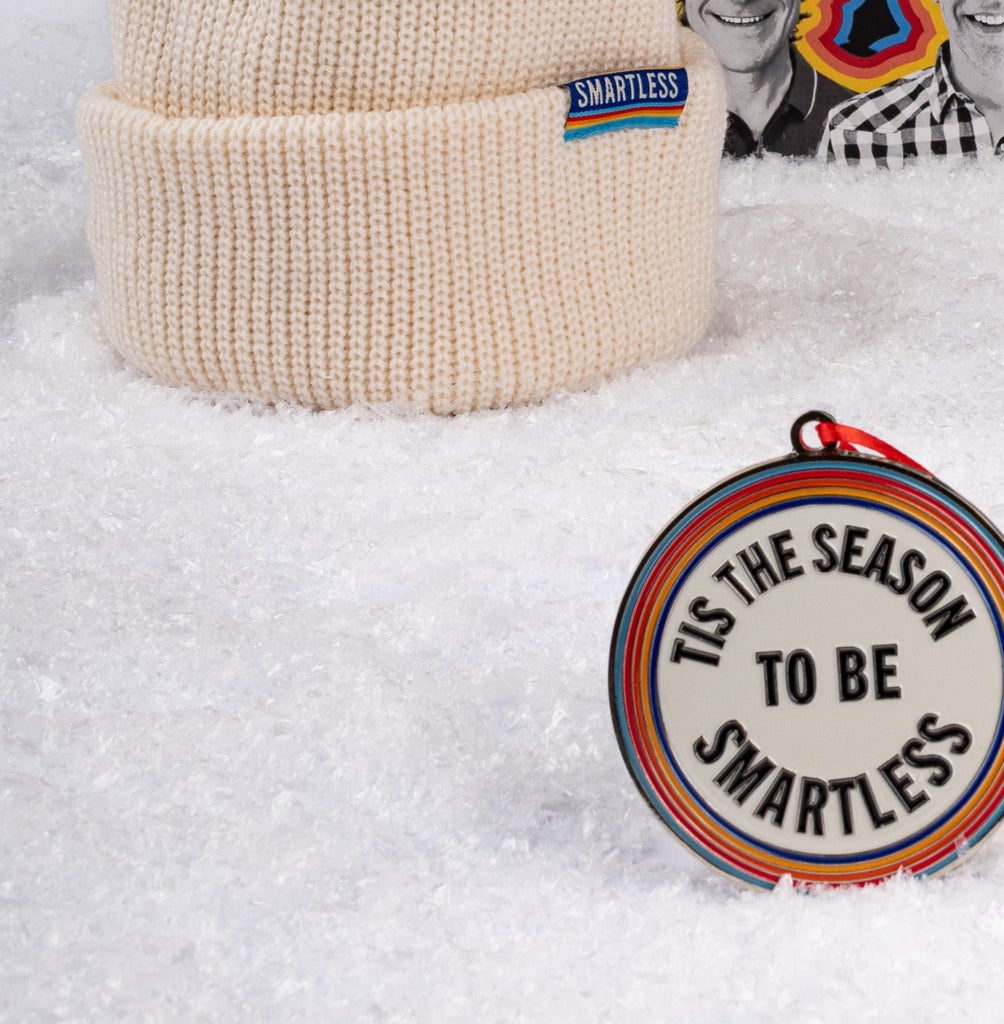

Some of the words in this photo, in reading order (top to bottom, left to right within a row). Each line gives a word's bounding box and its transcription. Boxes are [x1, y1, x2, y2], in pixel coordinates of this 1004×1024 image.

[575, 72, 679, 108] SMARTLESS
[669, 596, 736, 667] TIS
[712, 529, 804, 606] THE
[811, 523, 977, 642] SEASON
[755, 648, 817, 707] TO
[836, 643, 902, 702] BE
[693, 713, 973, 837] SMARTLESS
